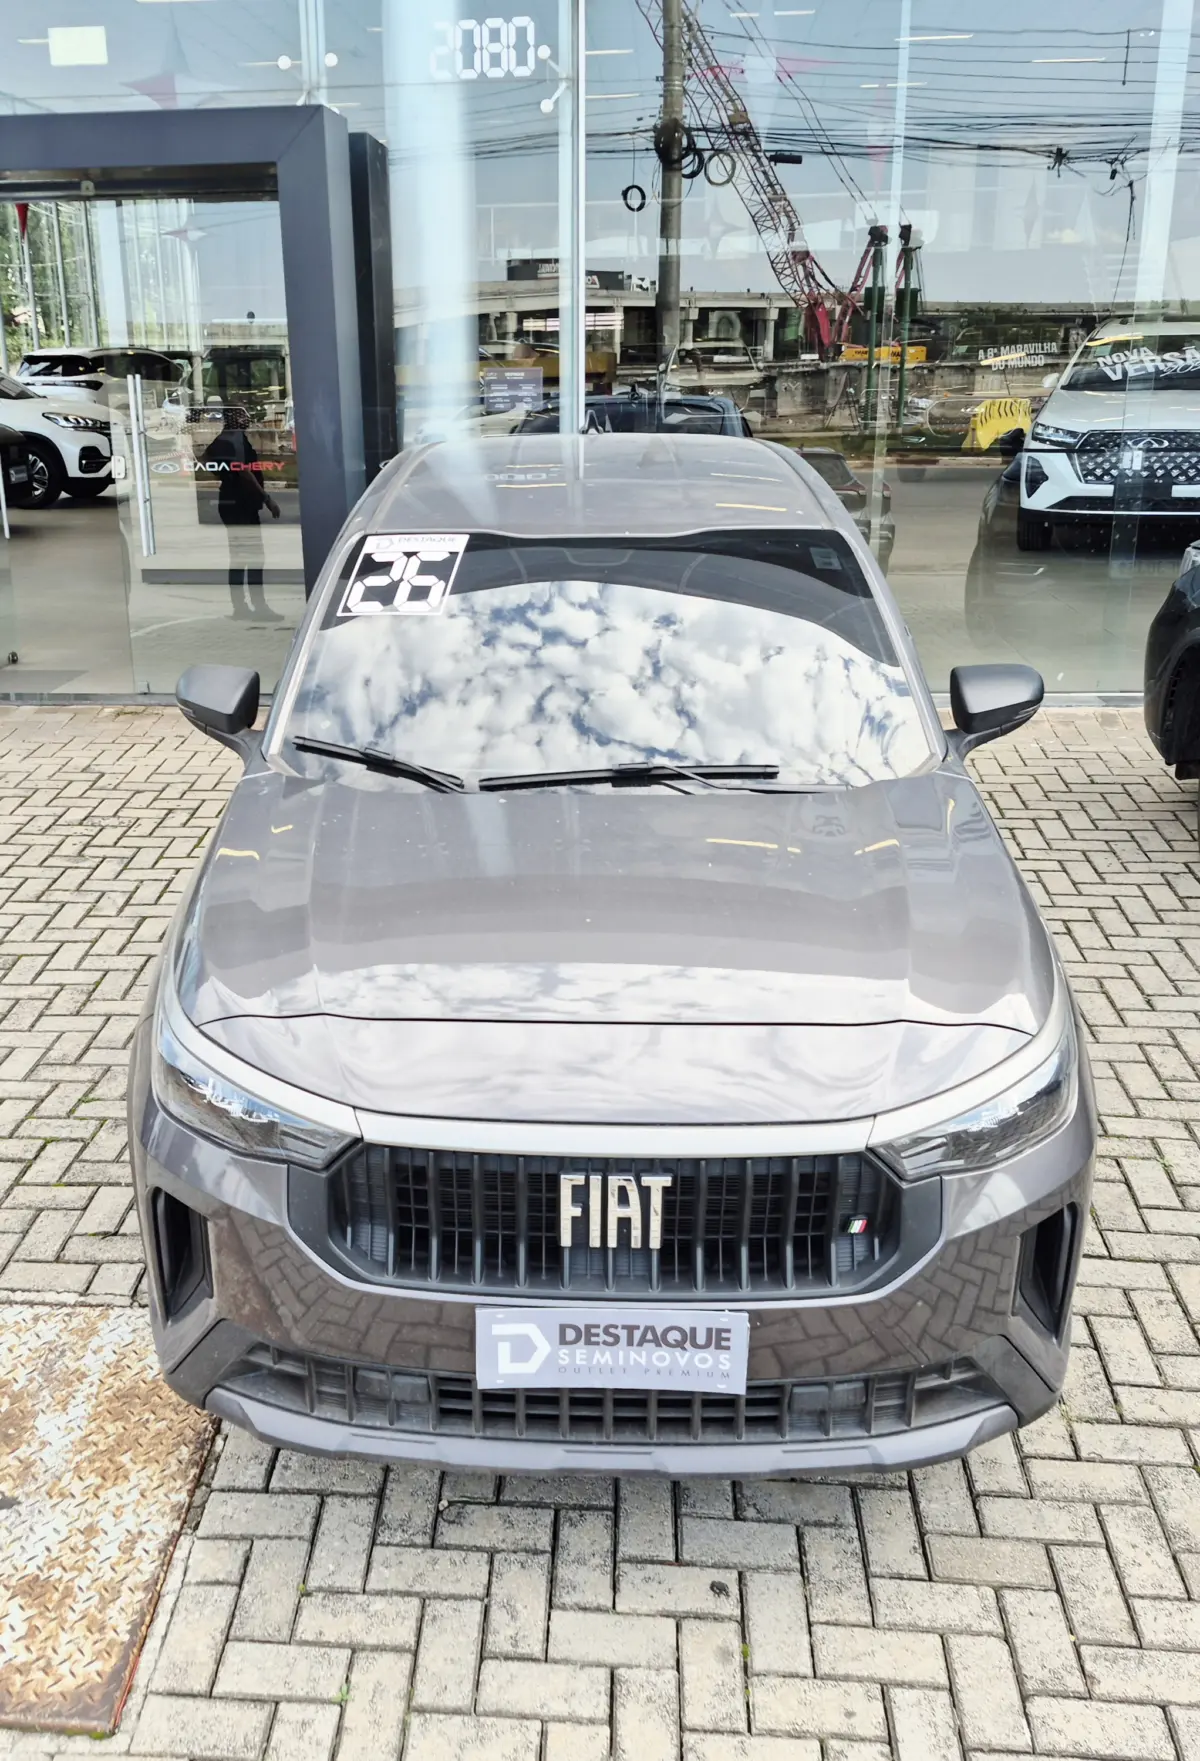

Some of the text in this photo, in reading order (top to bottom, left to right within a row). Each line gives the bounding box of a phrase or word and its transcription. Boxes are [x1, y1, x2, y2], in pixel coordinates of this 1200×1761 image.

[429, 16, 535, 79] 2080
[1000, 342, 1058, 358] MARAVILHA
[1097, 346, 1154, 367] NOVA
[991, 354, 1045, 371] DO MUNDO
[346, 551, 450, 613] 26
[560, 1174, 672, 1249] FIAT
[558, 1323, 732, 1351] DESTAQUE
[557, 1348, 732, 1371] SEMINOVOS
[557, 1366, 731, 1380] OUTLET PREMIUM
